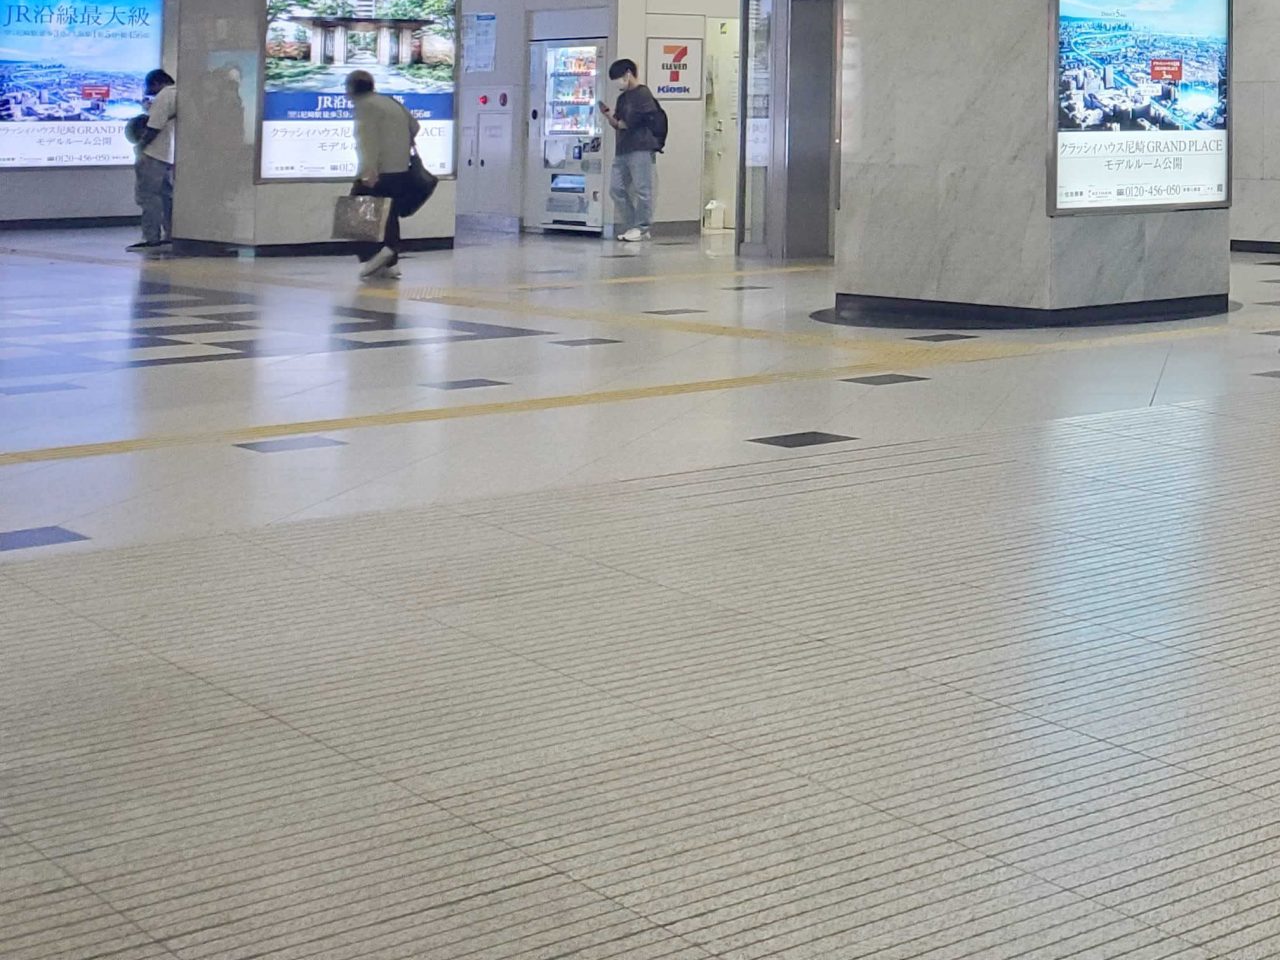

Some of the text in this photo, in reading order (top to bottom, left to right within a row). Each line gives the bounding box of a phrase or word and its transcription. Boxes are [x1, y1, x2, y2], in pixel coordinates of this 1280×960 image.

[3, 4, 150, 27] JR沿線最大級
[663, 45, 688, 82] 7
[657, 85, 690, 93] Kiosk
[77, 126, 116, 134] GRAND
[271, 127, 351, 138] クラッシィハウス尼
[1147, 140, 1187, 153] GRAND
[1188, 139, 1223, 152] PLACE
[1104, 156, 1183, 171] モデルルーム公開
